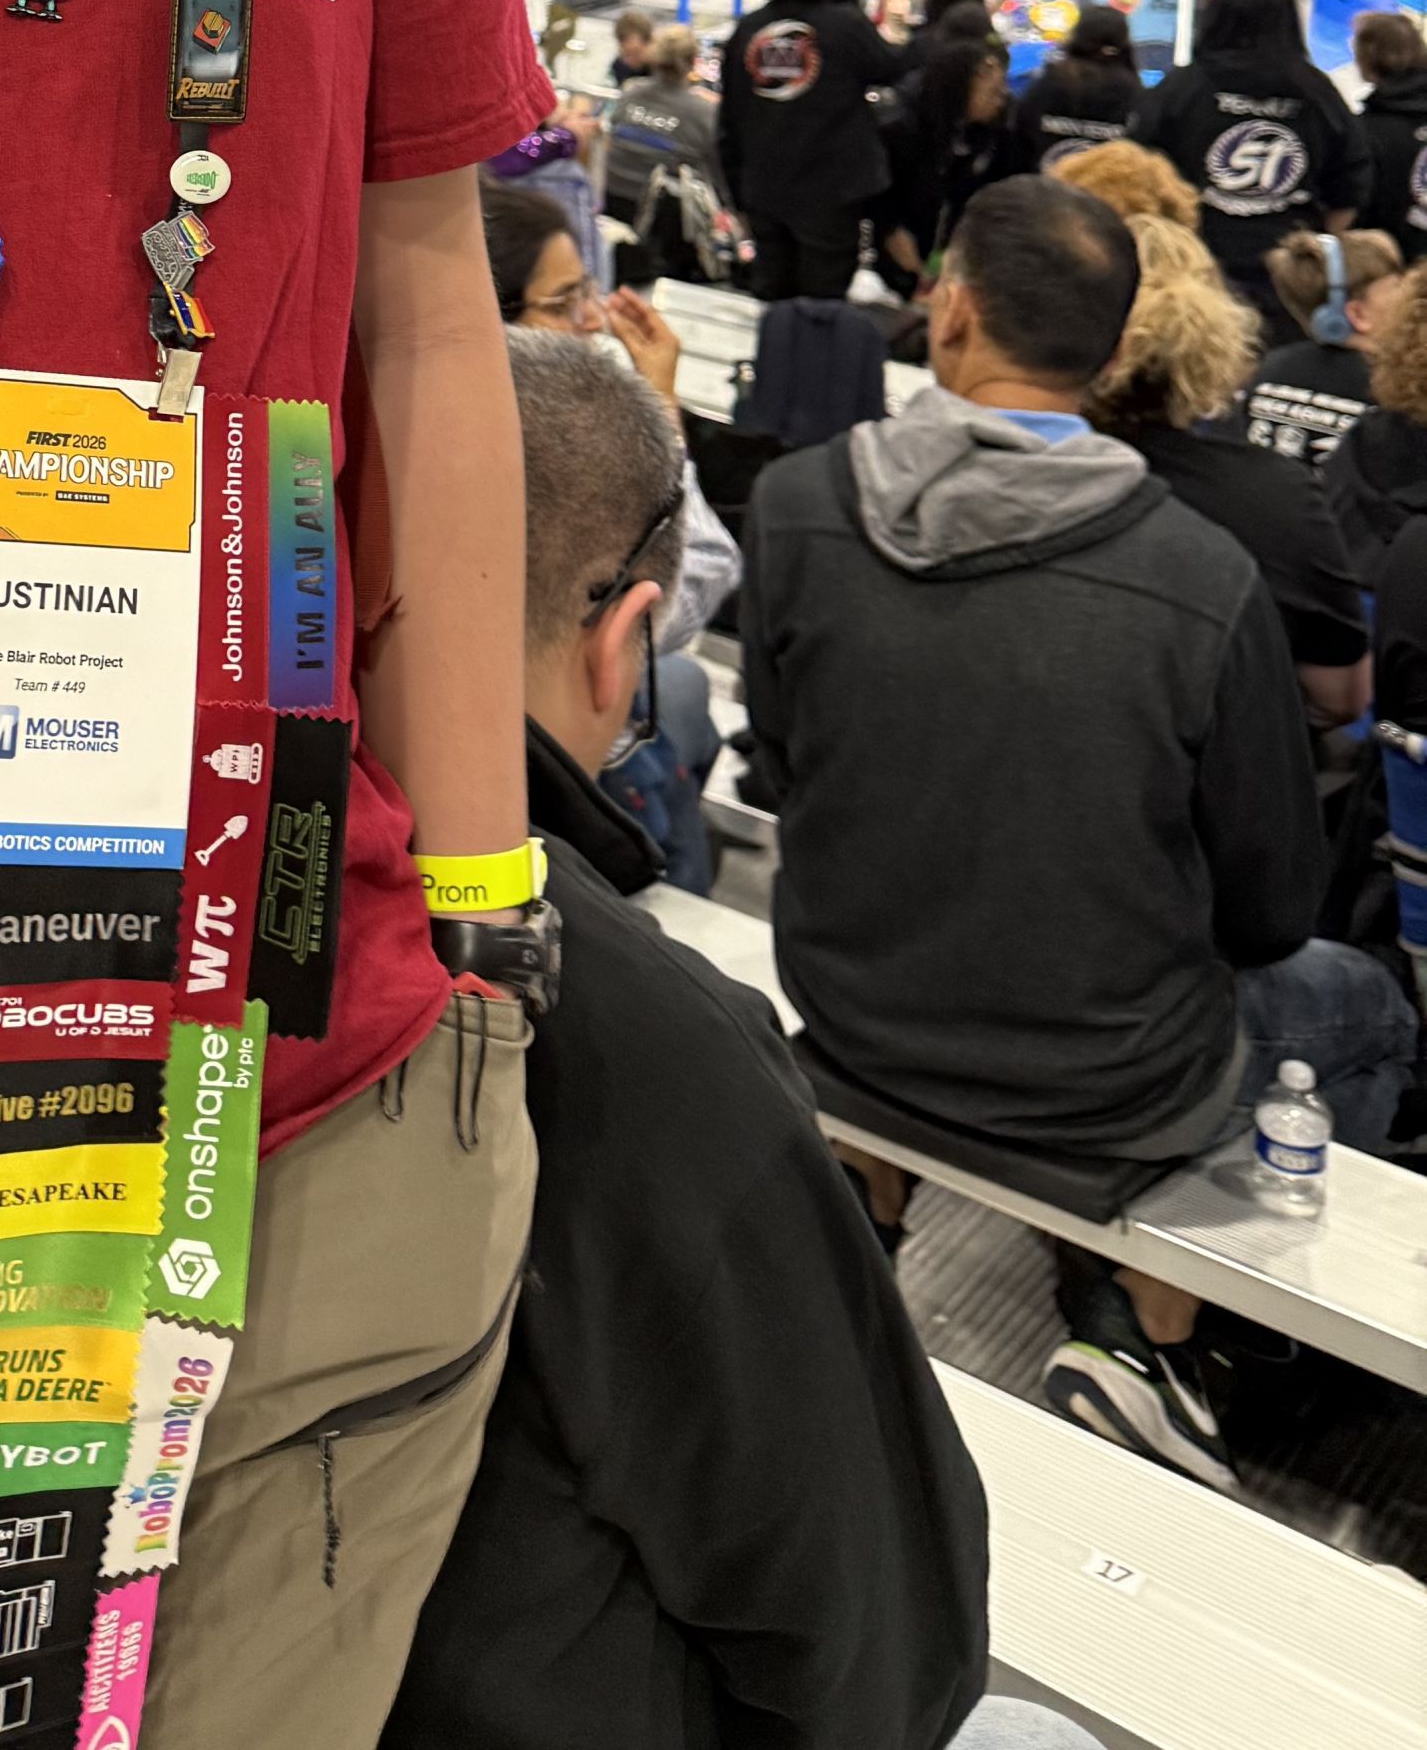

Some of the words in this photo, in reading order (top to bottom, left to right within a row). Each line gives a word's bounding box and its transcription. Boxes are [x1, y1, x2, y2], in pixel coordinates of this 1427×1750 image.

[26, 431, 72, 447] FIRST
[73, 434, 107, 450] 2026
[291, 450, 324, 533] ALLY
[221, 412, 243, 682] Johnson&Johnson
[294, 547, 325, 597] AN
[296, 612, 325, 669] I'M
[7, 650, 36, 663] Blair
[39, 652, 76, 665] Robot
[79, 654, 123, 670] Project
[14, 678, 48, 692] Team
[51, 680, 60, 692] #
[62, 681, 86, 693] 449
[26, 717, 120, 740] MOUSER
[24, 738, 119, 753] ELECTRONICS
[230, 748, 240, 773] WPI
[54, 836, 165, 855] COMPETITION
[259, 802, 311, 952] CTR
[309, 813, 333, 954] ELECTRONICS
[55, 1027, 67, 1037] U
[68, 1027, 88, 1037] OF
[103, 1027, 152, 1037] JESUIT
[233, 1068, 253, 1089] by
[38, 1082, 135, 1118] #2096
[185, 1032, 233, 1220] onshape
[14, 1377, 105, 1403] DEERE
[1093, 1558, 1134, 1586] 17
